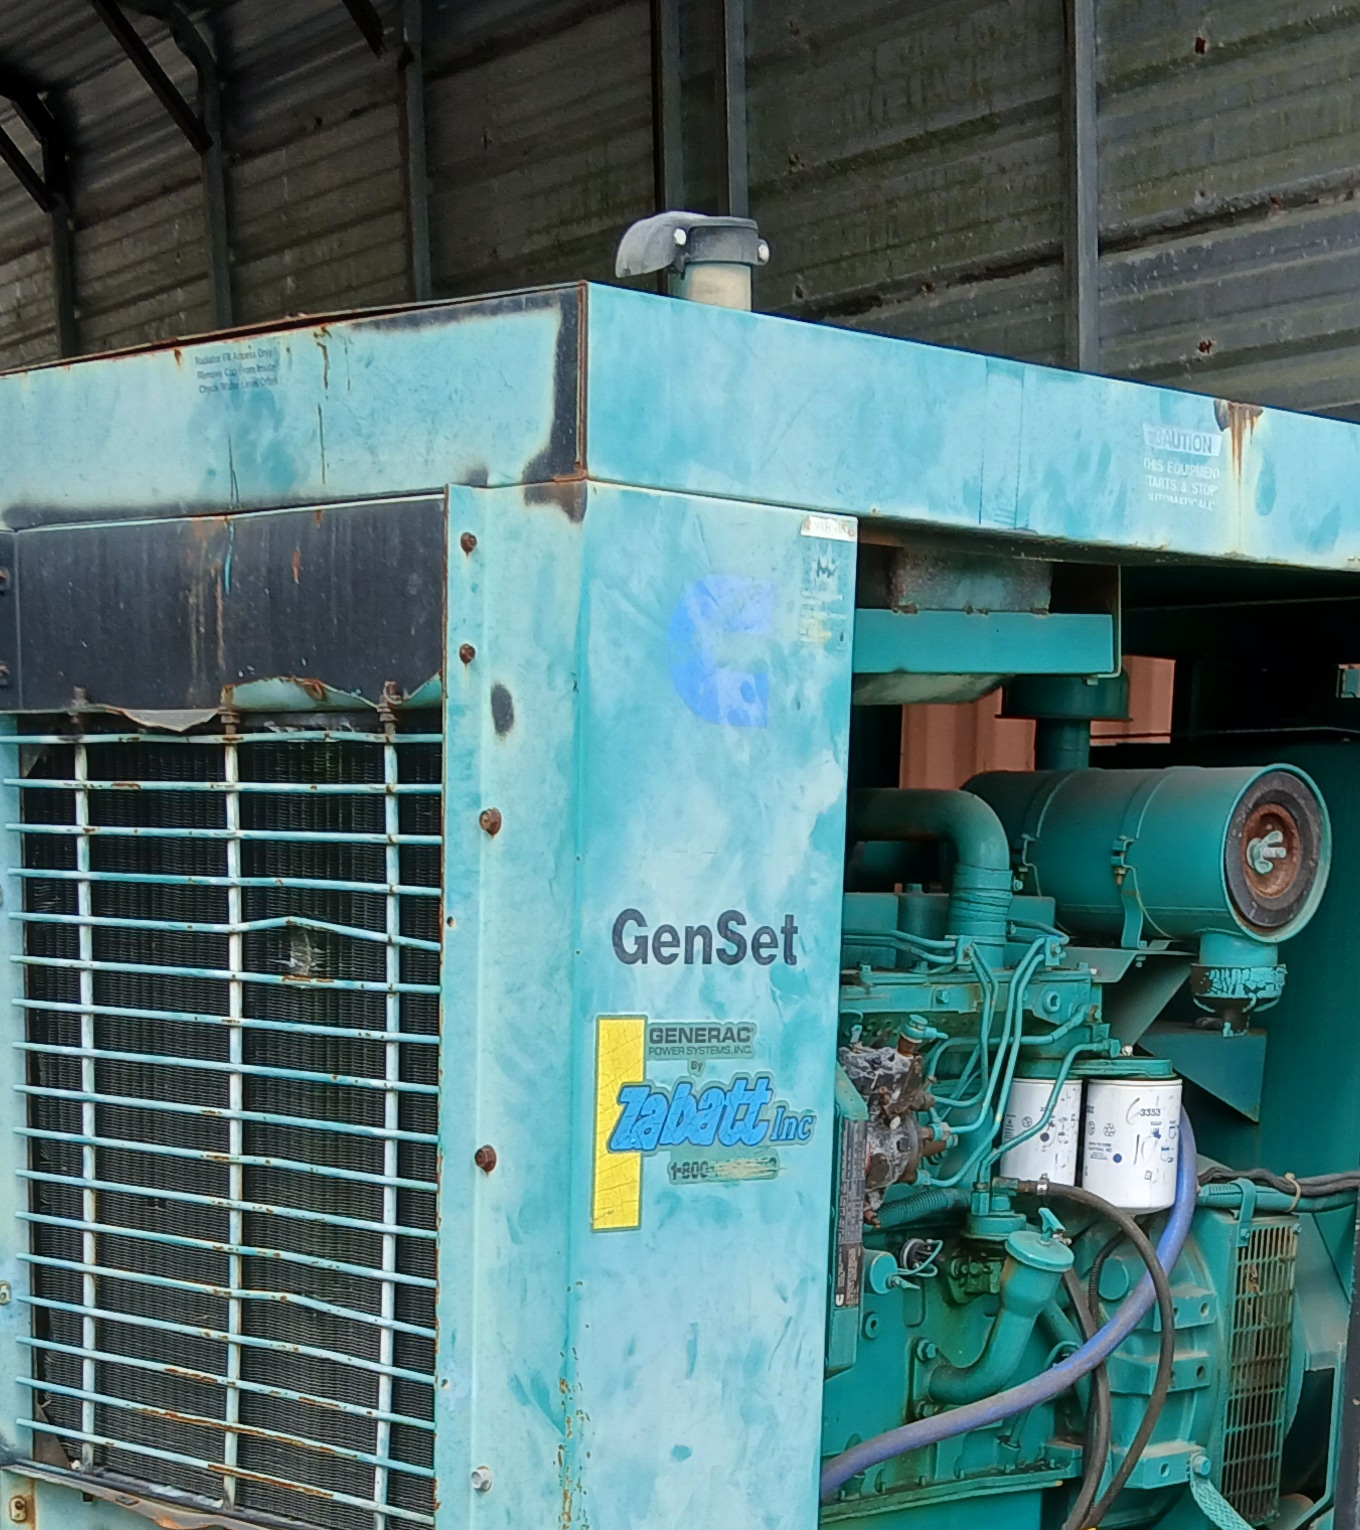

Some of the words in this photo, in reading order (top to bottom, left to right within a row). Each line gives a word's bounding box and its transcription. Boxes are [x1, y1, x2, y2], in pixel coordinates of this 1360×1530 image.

[1154, 426, 1213, 454] CAUTION
[1144, 457, 1163, 472] HIS
[1167, 461, 1220, 479] EQUIPMEN
[1145, 475, 1177, 491] TARTS
[1192, 482, 1218, 497] STOP
[611, 907, 799, 966] GenSet
[649, 1026, 753, 1045] GENERAC
[648, 1045, 685, 1057] POWER
[690, 1060, 703, 1072] By
[769, 1105, 816, 1142] Inc
